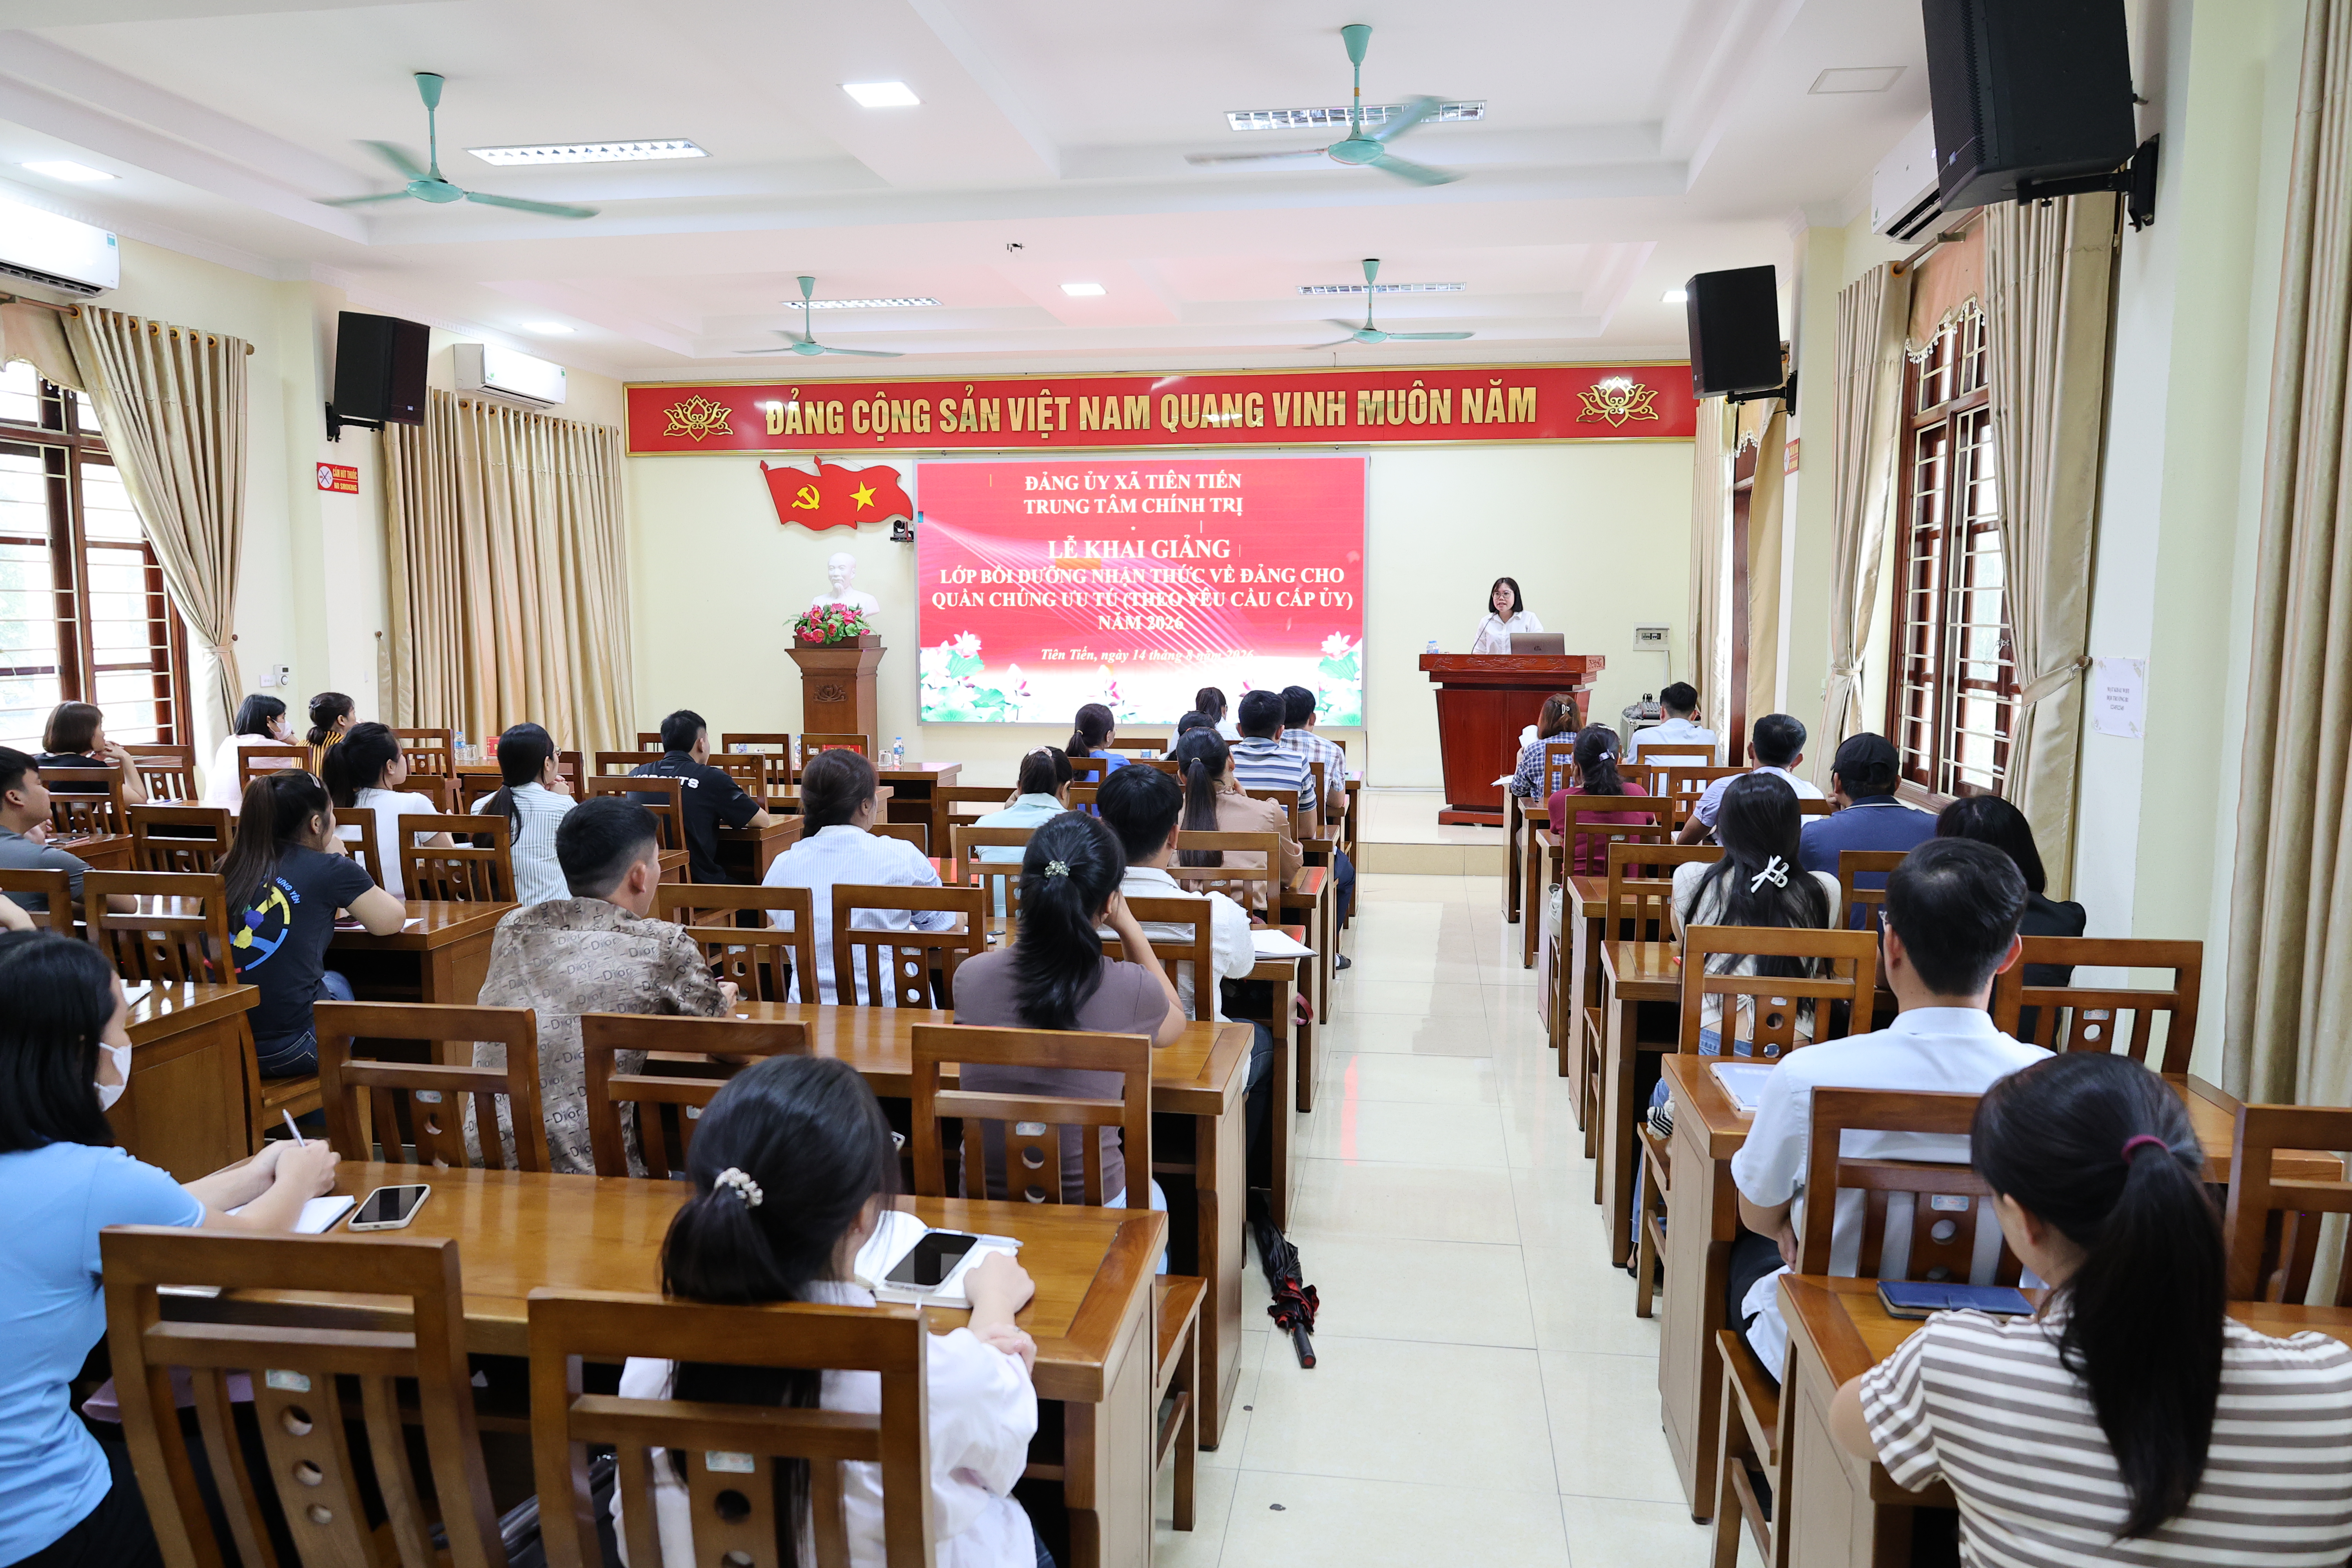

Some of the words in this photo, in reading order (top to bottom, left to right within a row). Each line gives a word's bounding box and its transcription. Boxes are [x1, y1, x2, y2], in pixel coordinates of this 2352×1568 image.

[765, 387, 844, 435] ĐẢNG
[852, 391, 931, 441] CỘNG
[939, 384, 1000, 432] SẢN
[1007, 388, 1071, 439] VIỆT
[1079, 395, 1150, 430] NAM
[1160, 392, 1264, 433] QUANG
[1272, 391, 1346, 427] VINH
[1357, 380, 1451, 425] MUÔN
[1461, 379, 1536, 423] NĂM
[340, 483, 357, 491] SMOKING
[1025, 471, 1079, 490] ĐẢNG
[1084, 471, 1110, 490] ỦY
[1114, 471, 1141, 490] XÃ
[1145, 469, 1191, 489] TIÊN
[1196, 469, 1241, 488] TIẾN
[1024, 499, 1090, 514] TRUNG
[1094, 494, 1137, 513] TÂM
[1142, 494, 1205, 513] CHÍNH
[1210, 497, 1243, 516] TRỊ
[1048, 535, 1078, 559] LỄ
[1084, 540, 1145, 559] KHAI
[1151, 535, 1230, 558] GIẢNG
[940, 565, 976, 584] LỚP
[980, 565, 1013, 584] BỒI
[1017, 565, 1087, 584] DƯỠNG
[1092, 566, 1145, 587] NHẬN
[1150, 564, 1205, 583] THỨC
[1209, 564, 1235, 583] VỀ
[1240, 564, 1296, 583] ĐẢNG
[1301, 568, 1345, 583] CHO
[932, 588, 984, 610] QUẦN
[989, 588, 1056, 607] CHÚNG
[1061, 590, 1088, 607] ƯU
[1093, 588, 1118, 607] TÚ
[1123, 592, 1183, 610] (THEO
[1187, 587, 1226, 606] YÊU
[1230, 588, 1271, 606] CẦU
[1276, 588, 1315, 606] CẤP
[1319, 587, 1353, 610] ỦY)
[1098, 612, 1142, 630] NĂM
[1147, 615, 1184, 630] 2026
[1042, 649, 1065, 660] Tiên
[1070, 646, 1097, 662] Tiến,
[1101, 649, 1129, 663] ngày
[1132, 649, 1146, 661] 14
[1149, 649, 1183, 663] tháng
[1186, 650, 1193, 661] 8
[1196, 650, 1221, 661] năm
[289, 890, 301, 904] YÊN
[563, 1051, 584, 1063] Dio
[553, 1109, 581, 1123] Dior
